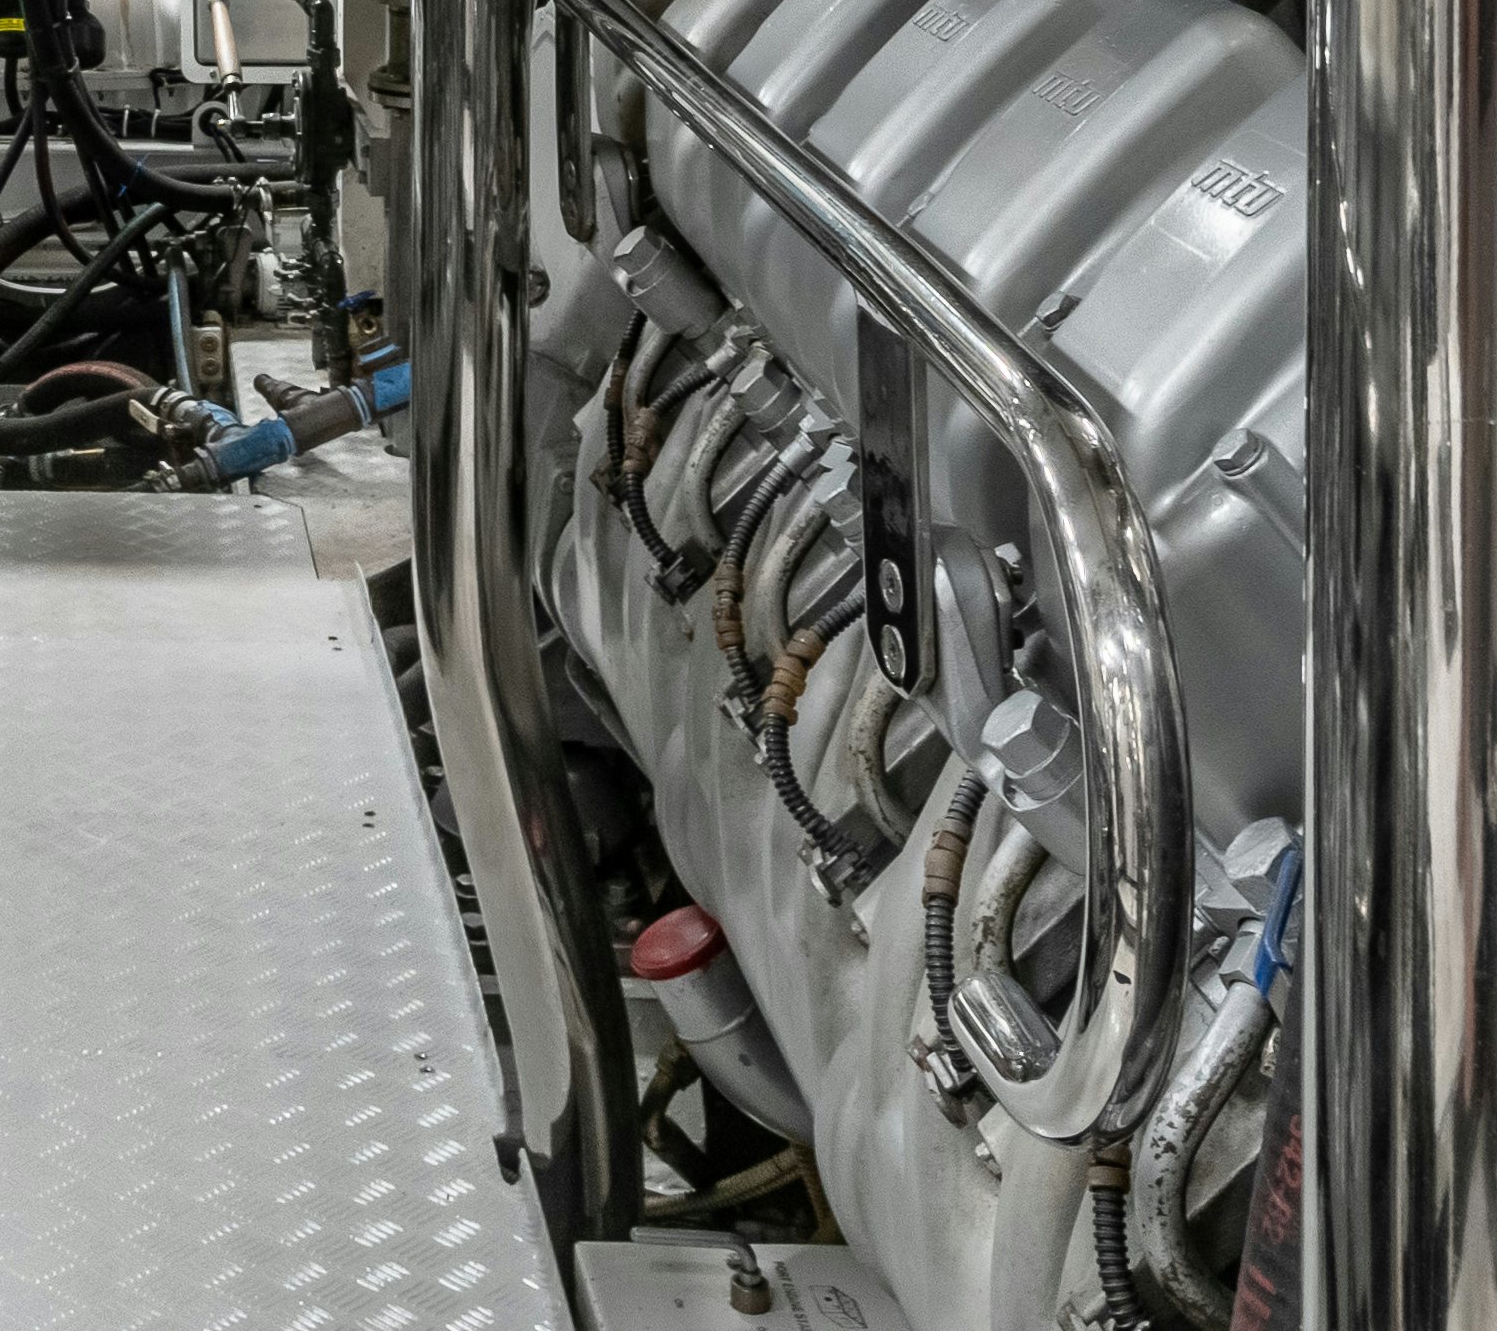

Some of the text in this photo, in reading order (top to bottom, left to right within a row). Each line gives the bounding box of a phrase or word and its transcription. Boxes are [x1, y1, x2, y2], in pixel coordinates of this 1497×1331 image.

[912, 6, 969, 43] mtu
[1033, 71, 1102, 117] mtu
[1190, 159, 1288, 218] mtu
[775, 1261, 792, 1282] PORT
[794, 1313, 811, 1331] STA
